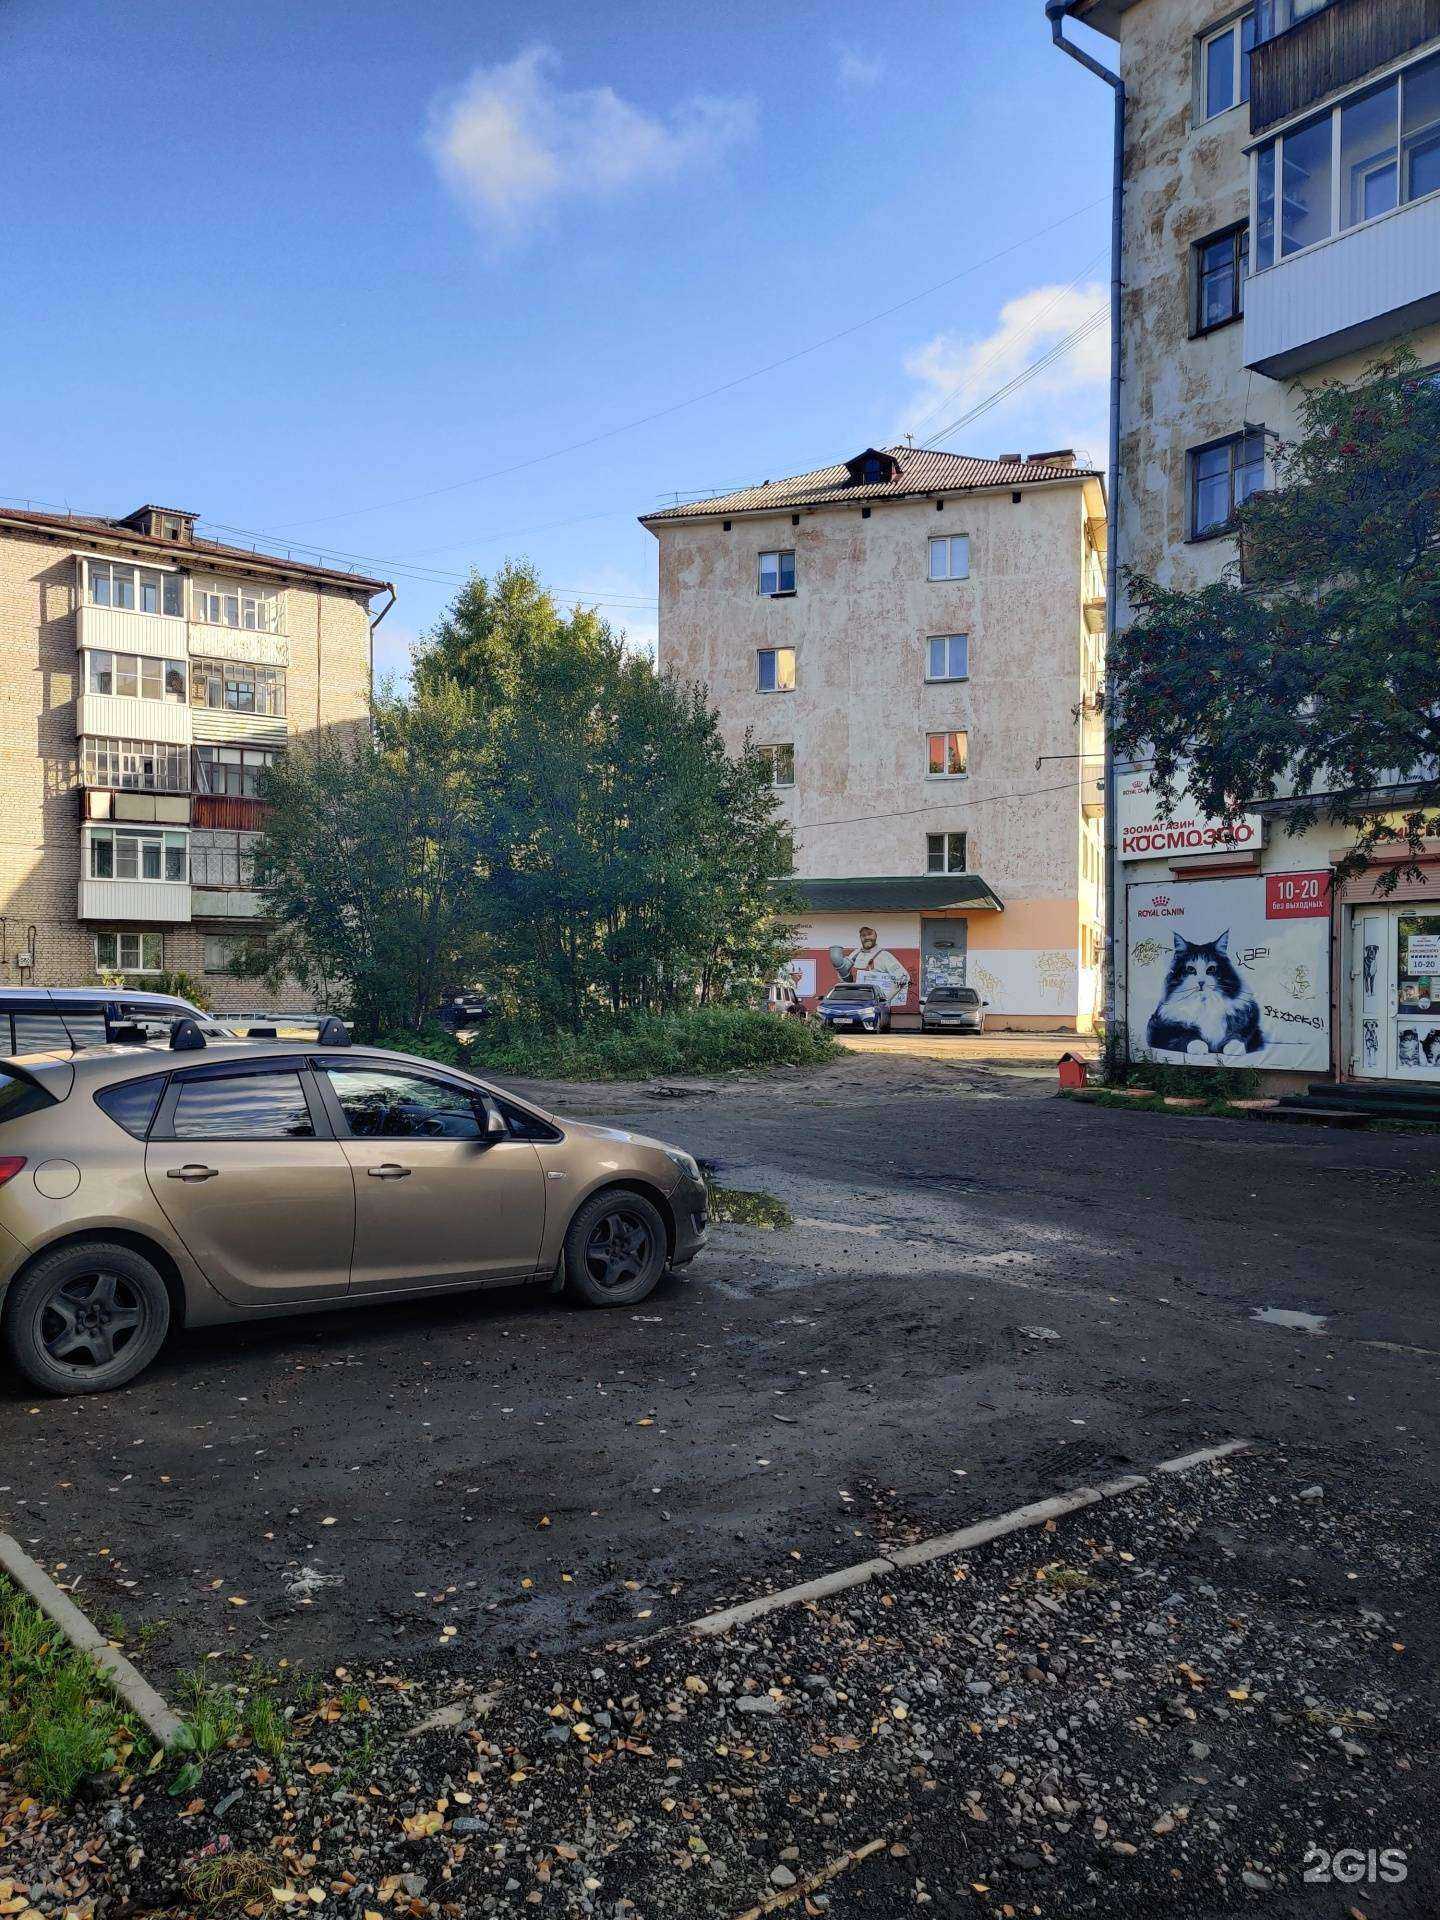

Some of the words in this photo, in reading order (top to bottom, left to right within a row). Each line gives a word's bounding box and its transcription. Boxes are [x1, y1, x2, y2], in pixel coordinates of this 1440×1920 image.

[1122, 820, 1195, 835] ЗООМАГАЗИН
[1278, 880, 1319, 899] 10-20
[1272, 901, 1285, 910] без
[1285, 900, 1323, 910] выходных
[1137, 909, 1160, 918] ROYAL
[1161, 907, 1185, 917] CANIN
[1413, 960, 1436, 969] 10-20
